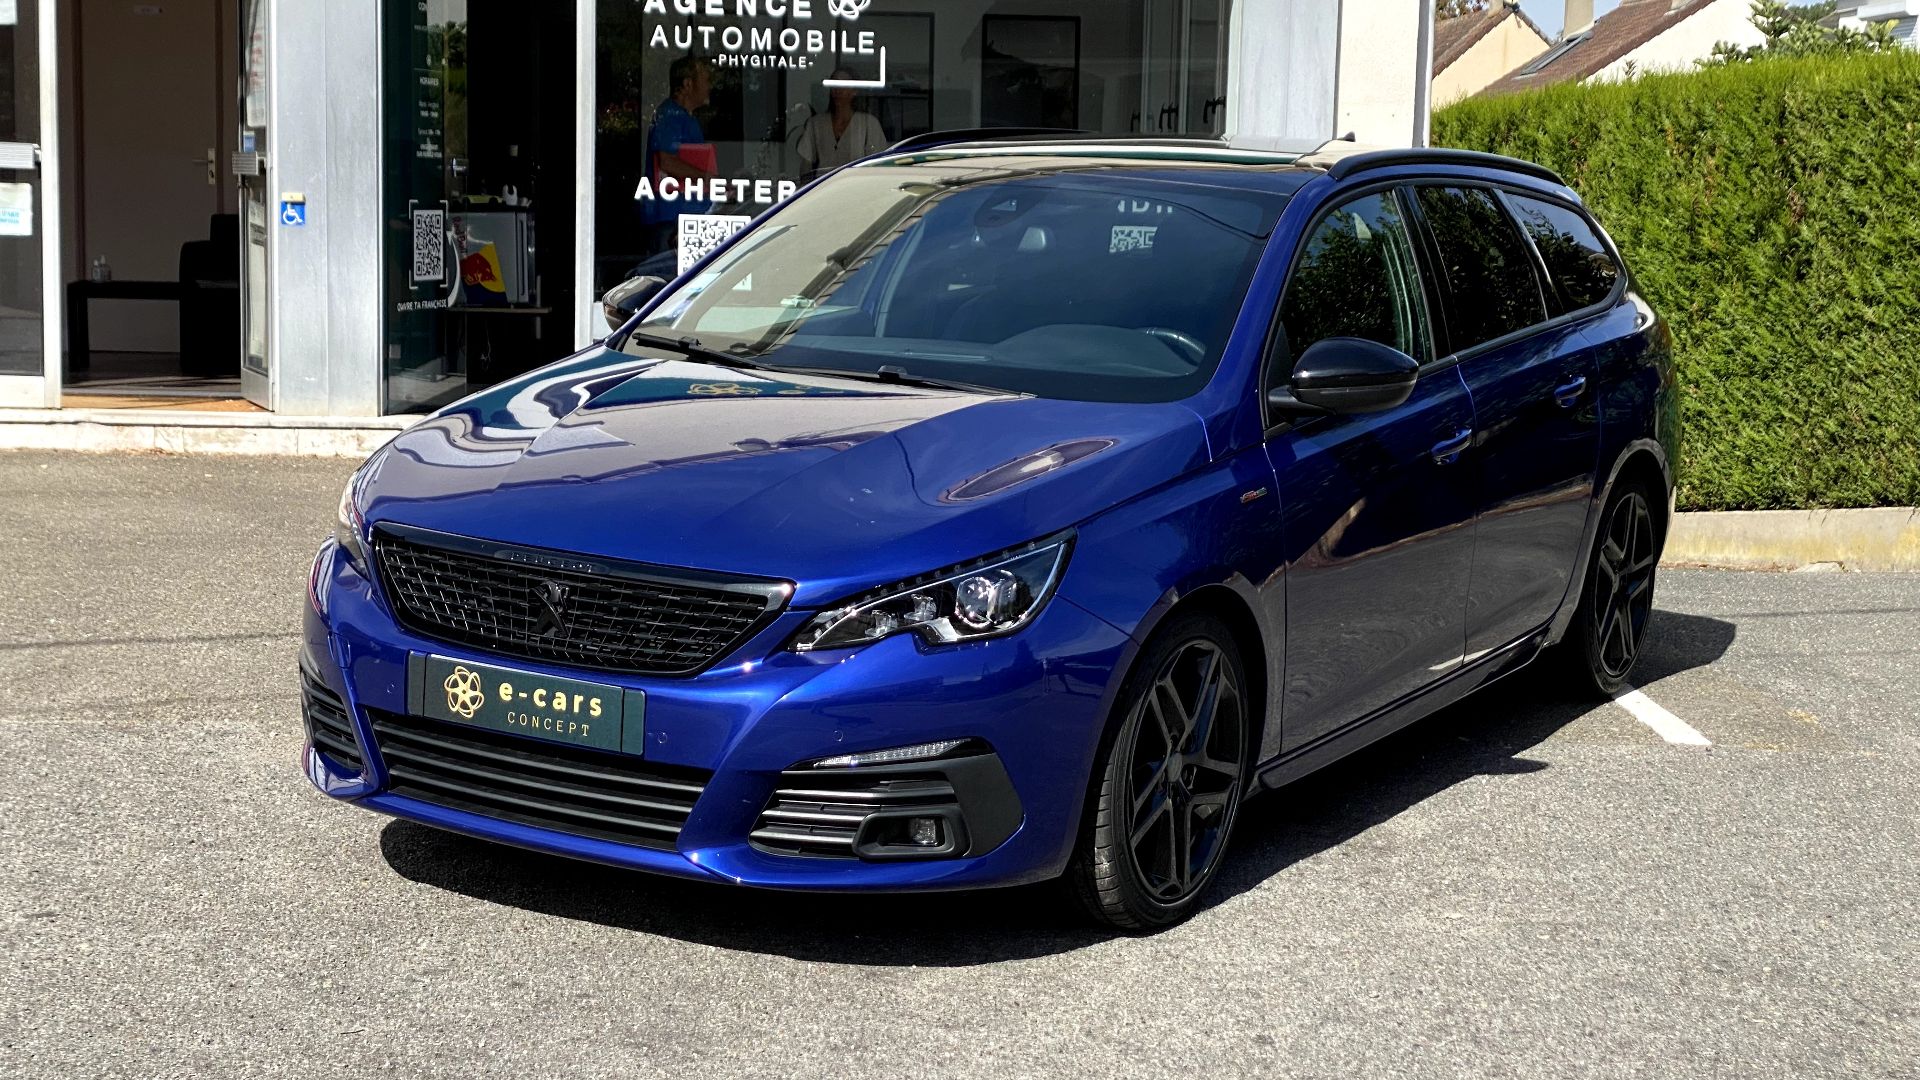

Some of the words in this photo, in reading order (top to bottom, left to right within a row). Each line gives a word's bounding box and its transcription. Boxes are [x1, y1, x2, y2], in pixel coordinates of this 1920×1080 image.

[643, 0, 812, 18] AGENCE
[650, 24, 875, 53] AUTOMOBILE
[634, 176, 796, 203] ACHETER
[499, 682, 602, 717] e-cars
[507, 711, 590, 737] CONCEPT
